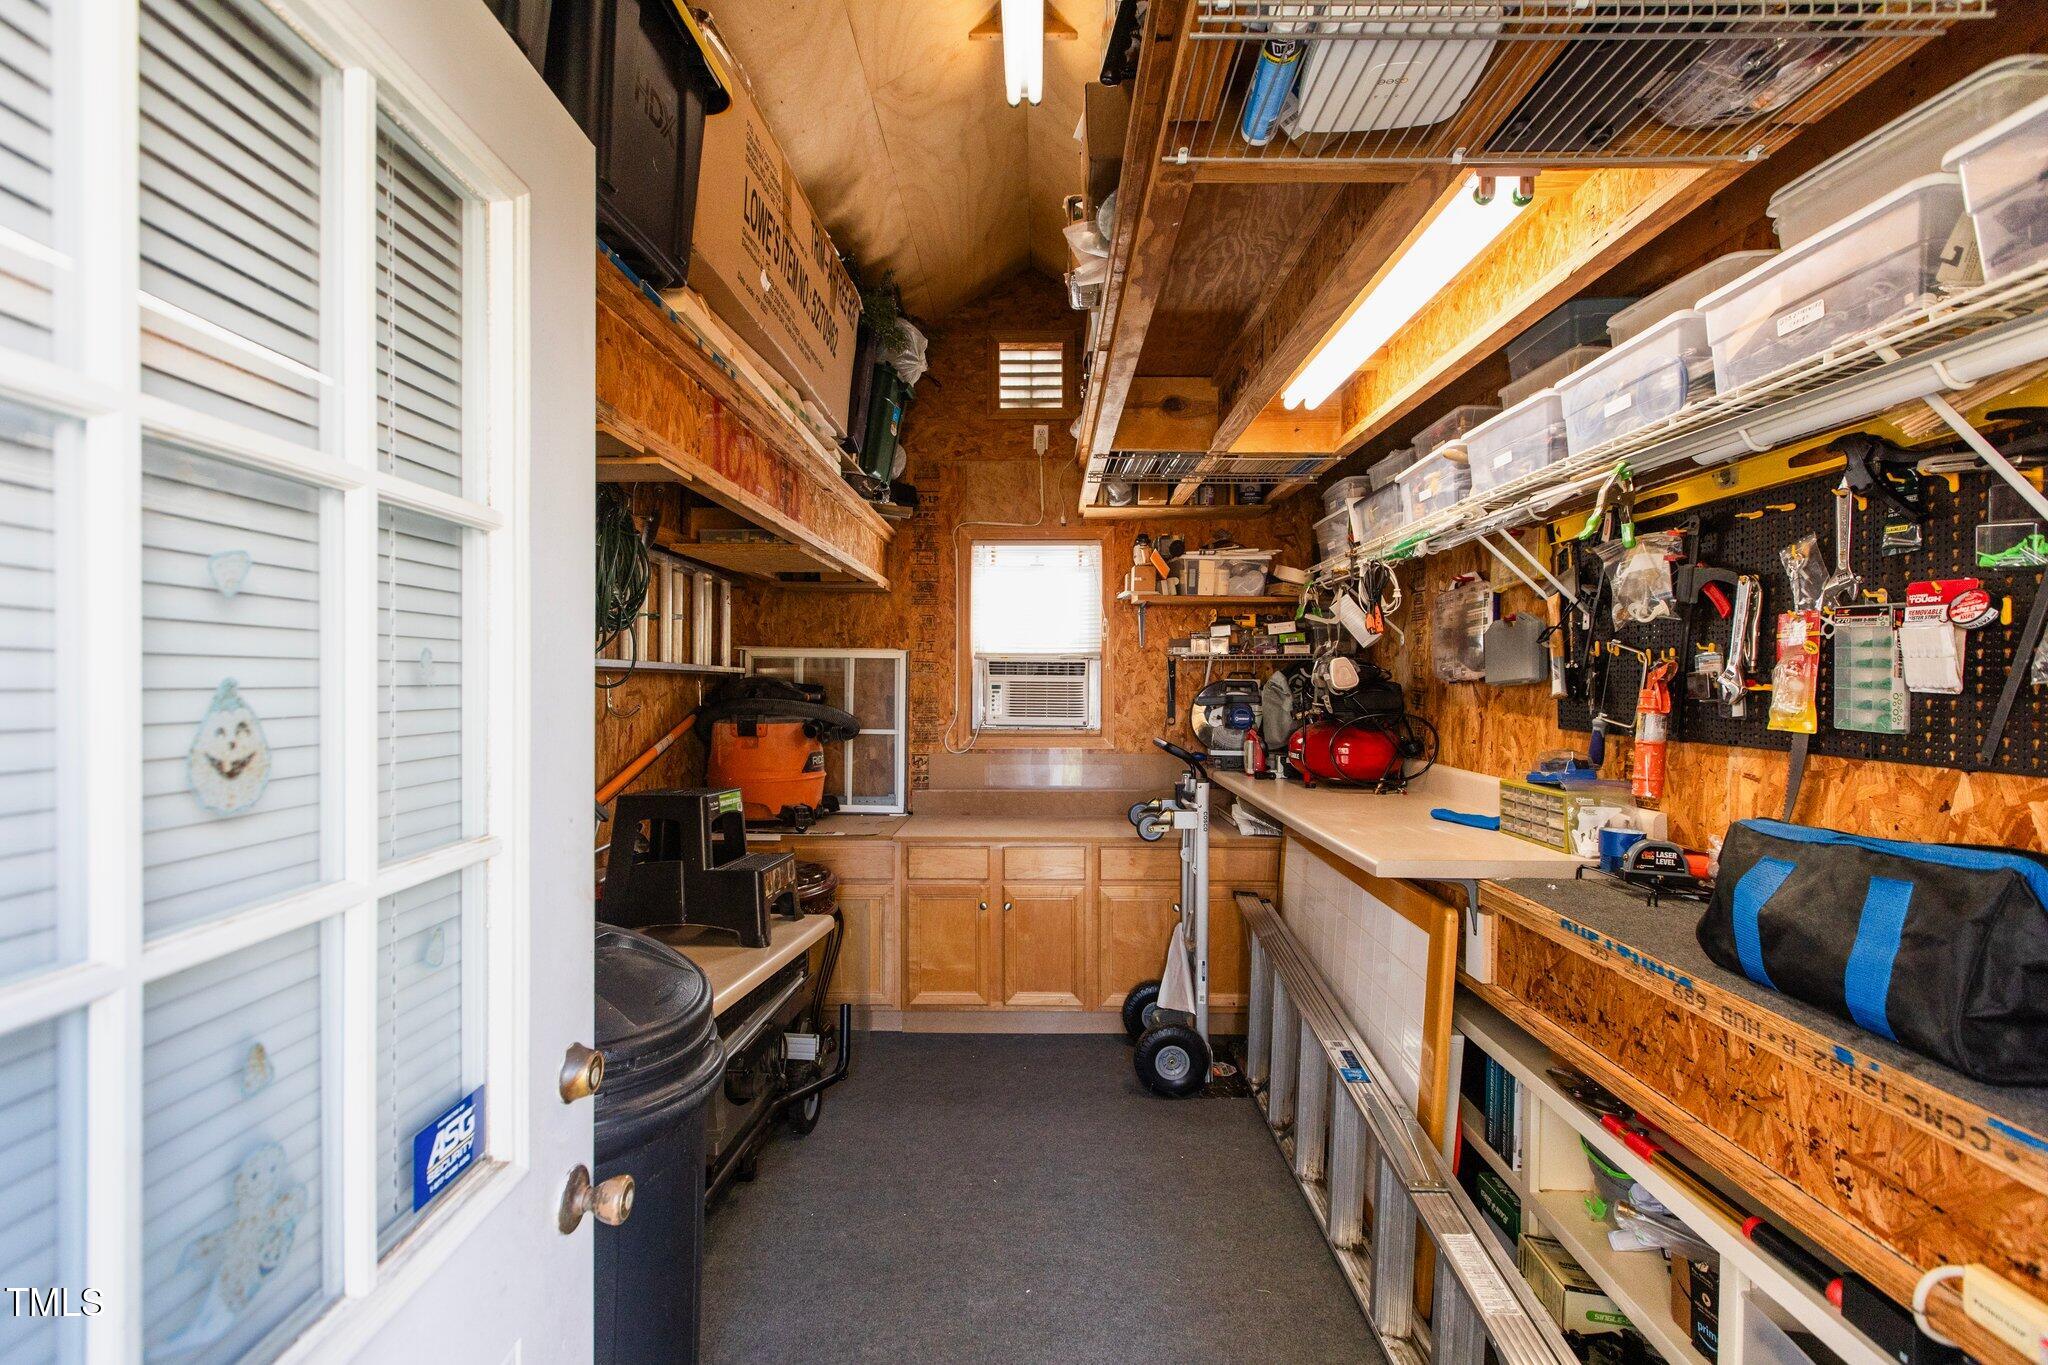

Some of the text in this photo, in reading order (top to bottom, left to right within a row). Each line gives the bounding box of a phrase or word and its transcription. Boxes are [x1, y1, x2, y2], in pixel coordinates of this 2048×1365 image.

[634, 77, 676, 149] HDX
[744, 175, 781, 265] LOWE'S
[780, 233, 799, 295] ITEM
[1908, 608, 1943, 616] REMOVABLE
[1910, 596, 1942, 604] TOUGH
[1655, 851, 1678, 859] LASER
[427, 1103, 476, 1173] ASG
[1904, 1092, 1992, 1151] CCMC
[1697, 1321, 1718, 1344] prim
